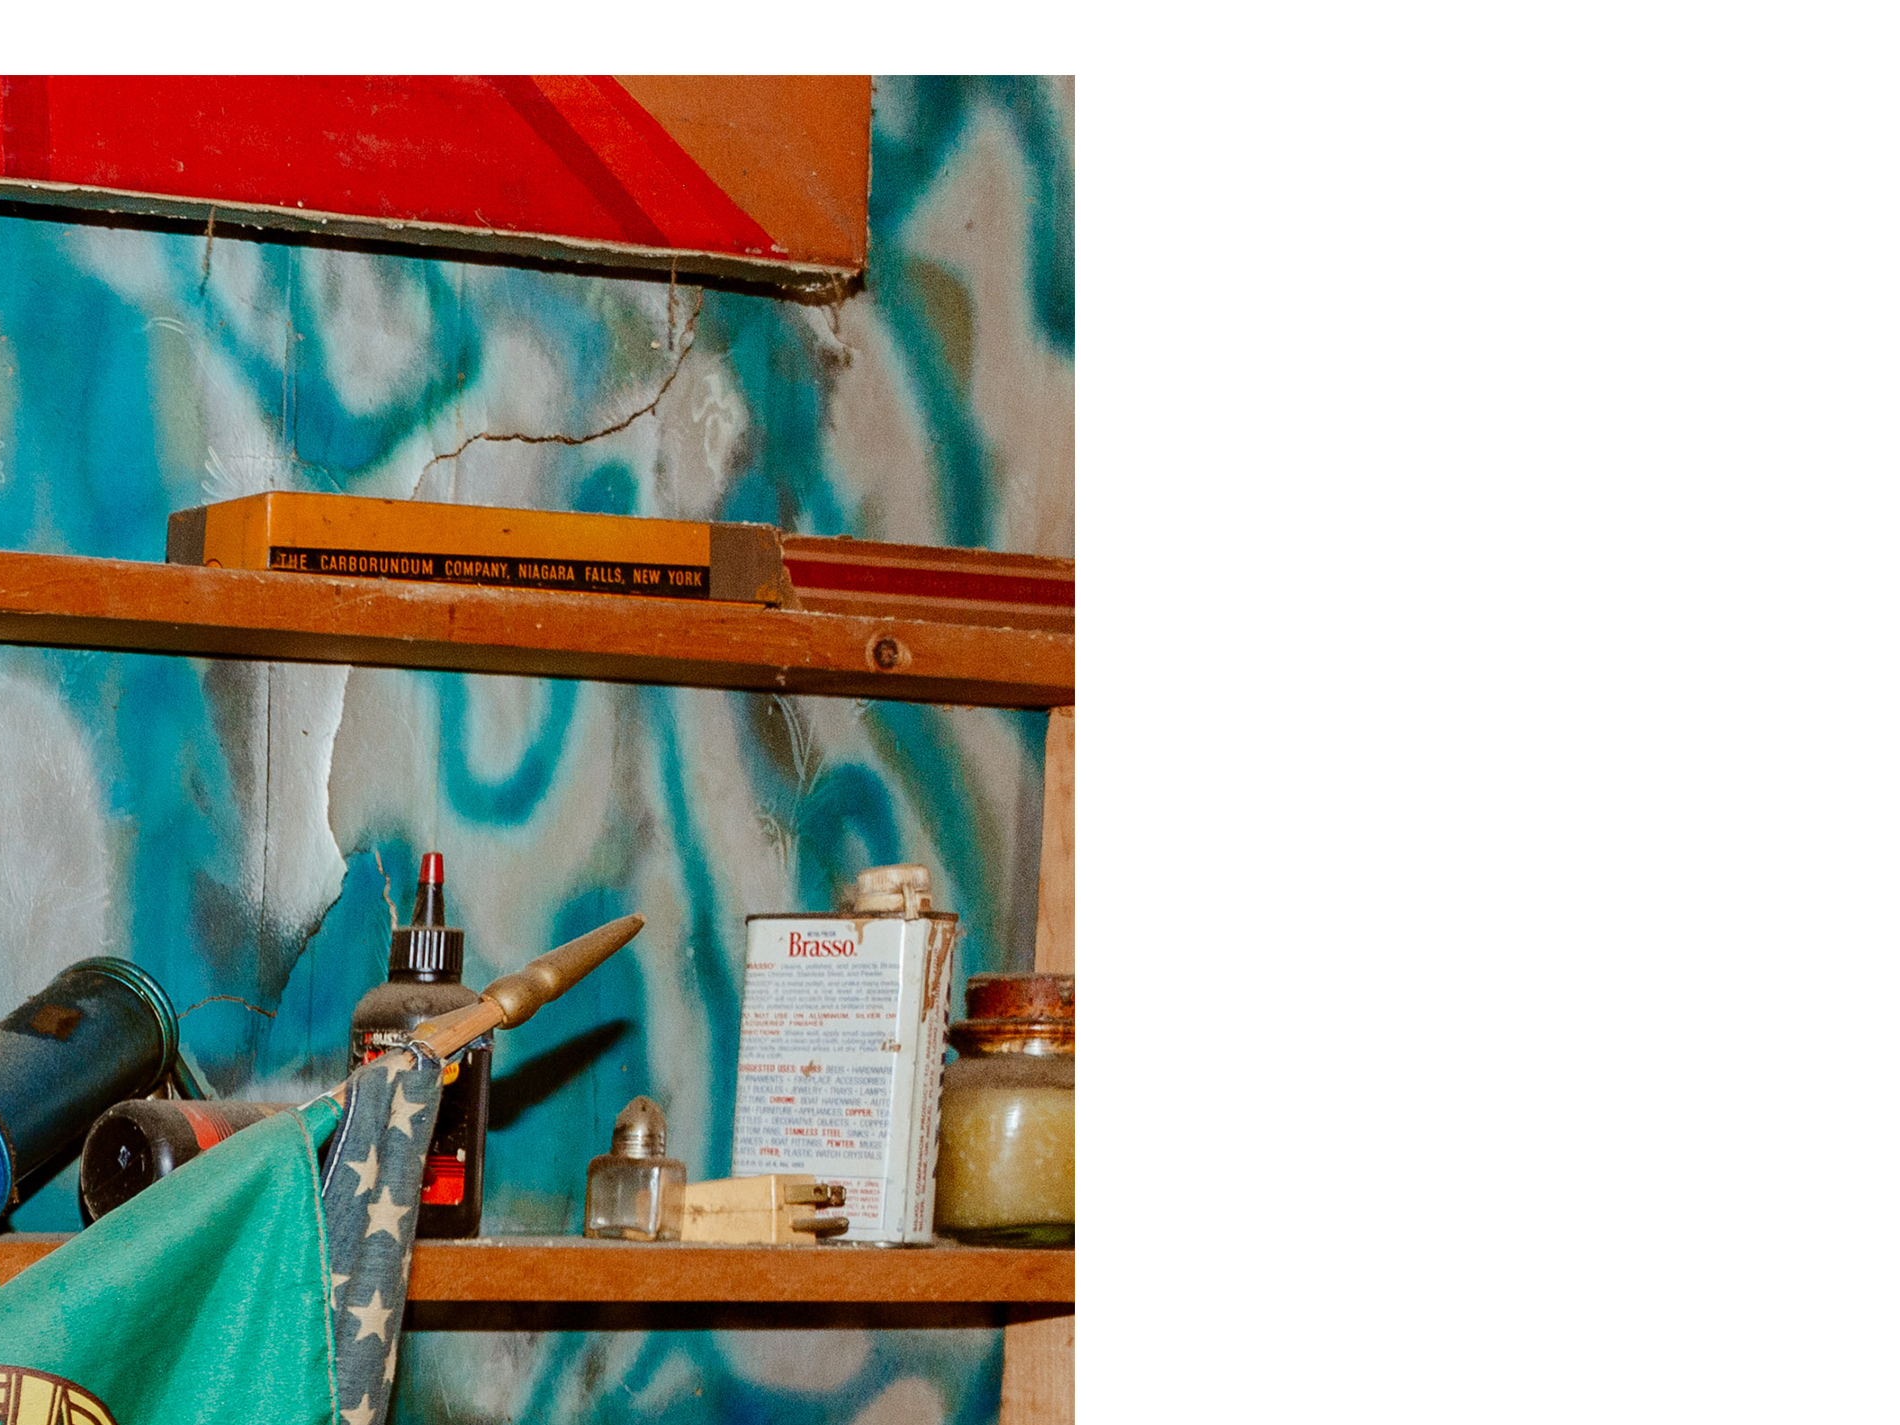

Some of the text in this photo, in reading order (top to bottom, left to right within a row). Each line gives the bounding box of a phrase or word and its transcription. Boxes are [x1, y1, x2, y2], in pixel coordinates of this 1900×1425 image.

[278, 552, 703, 588] THE CARBORUNDUM COMPANY, NIAGARA FALLS, NEW YORK
[789, 930, 856, 959] Brasso
